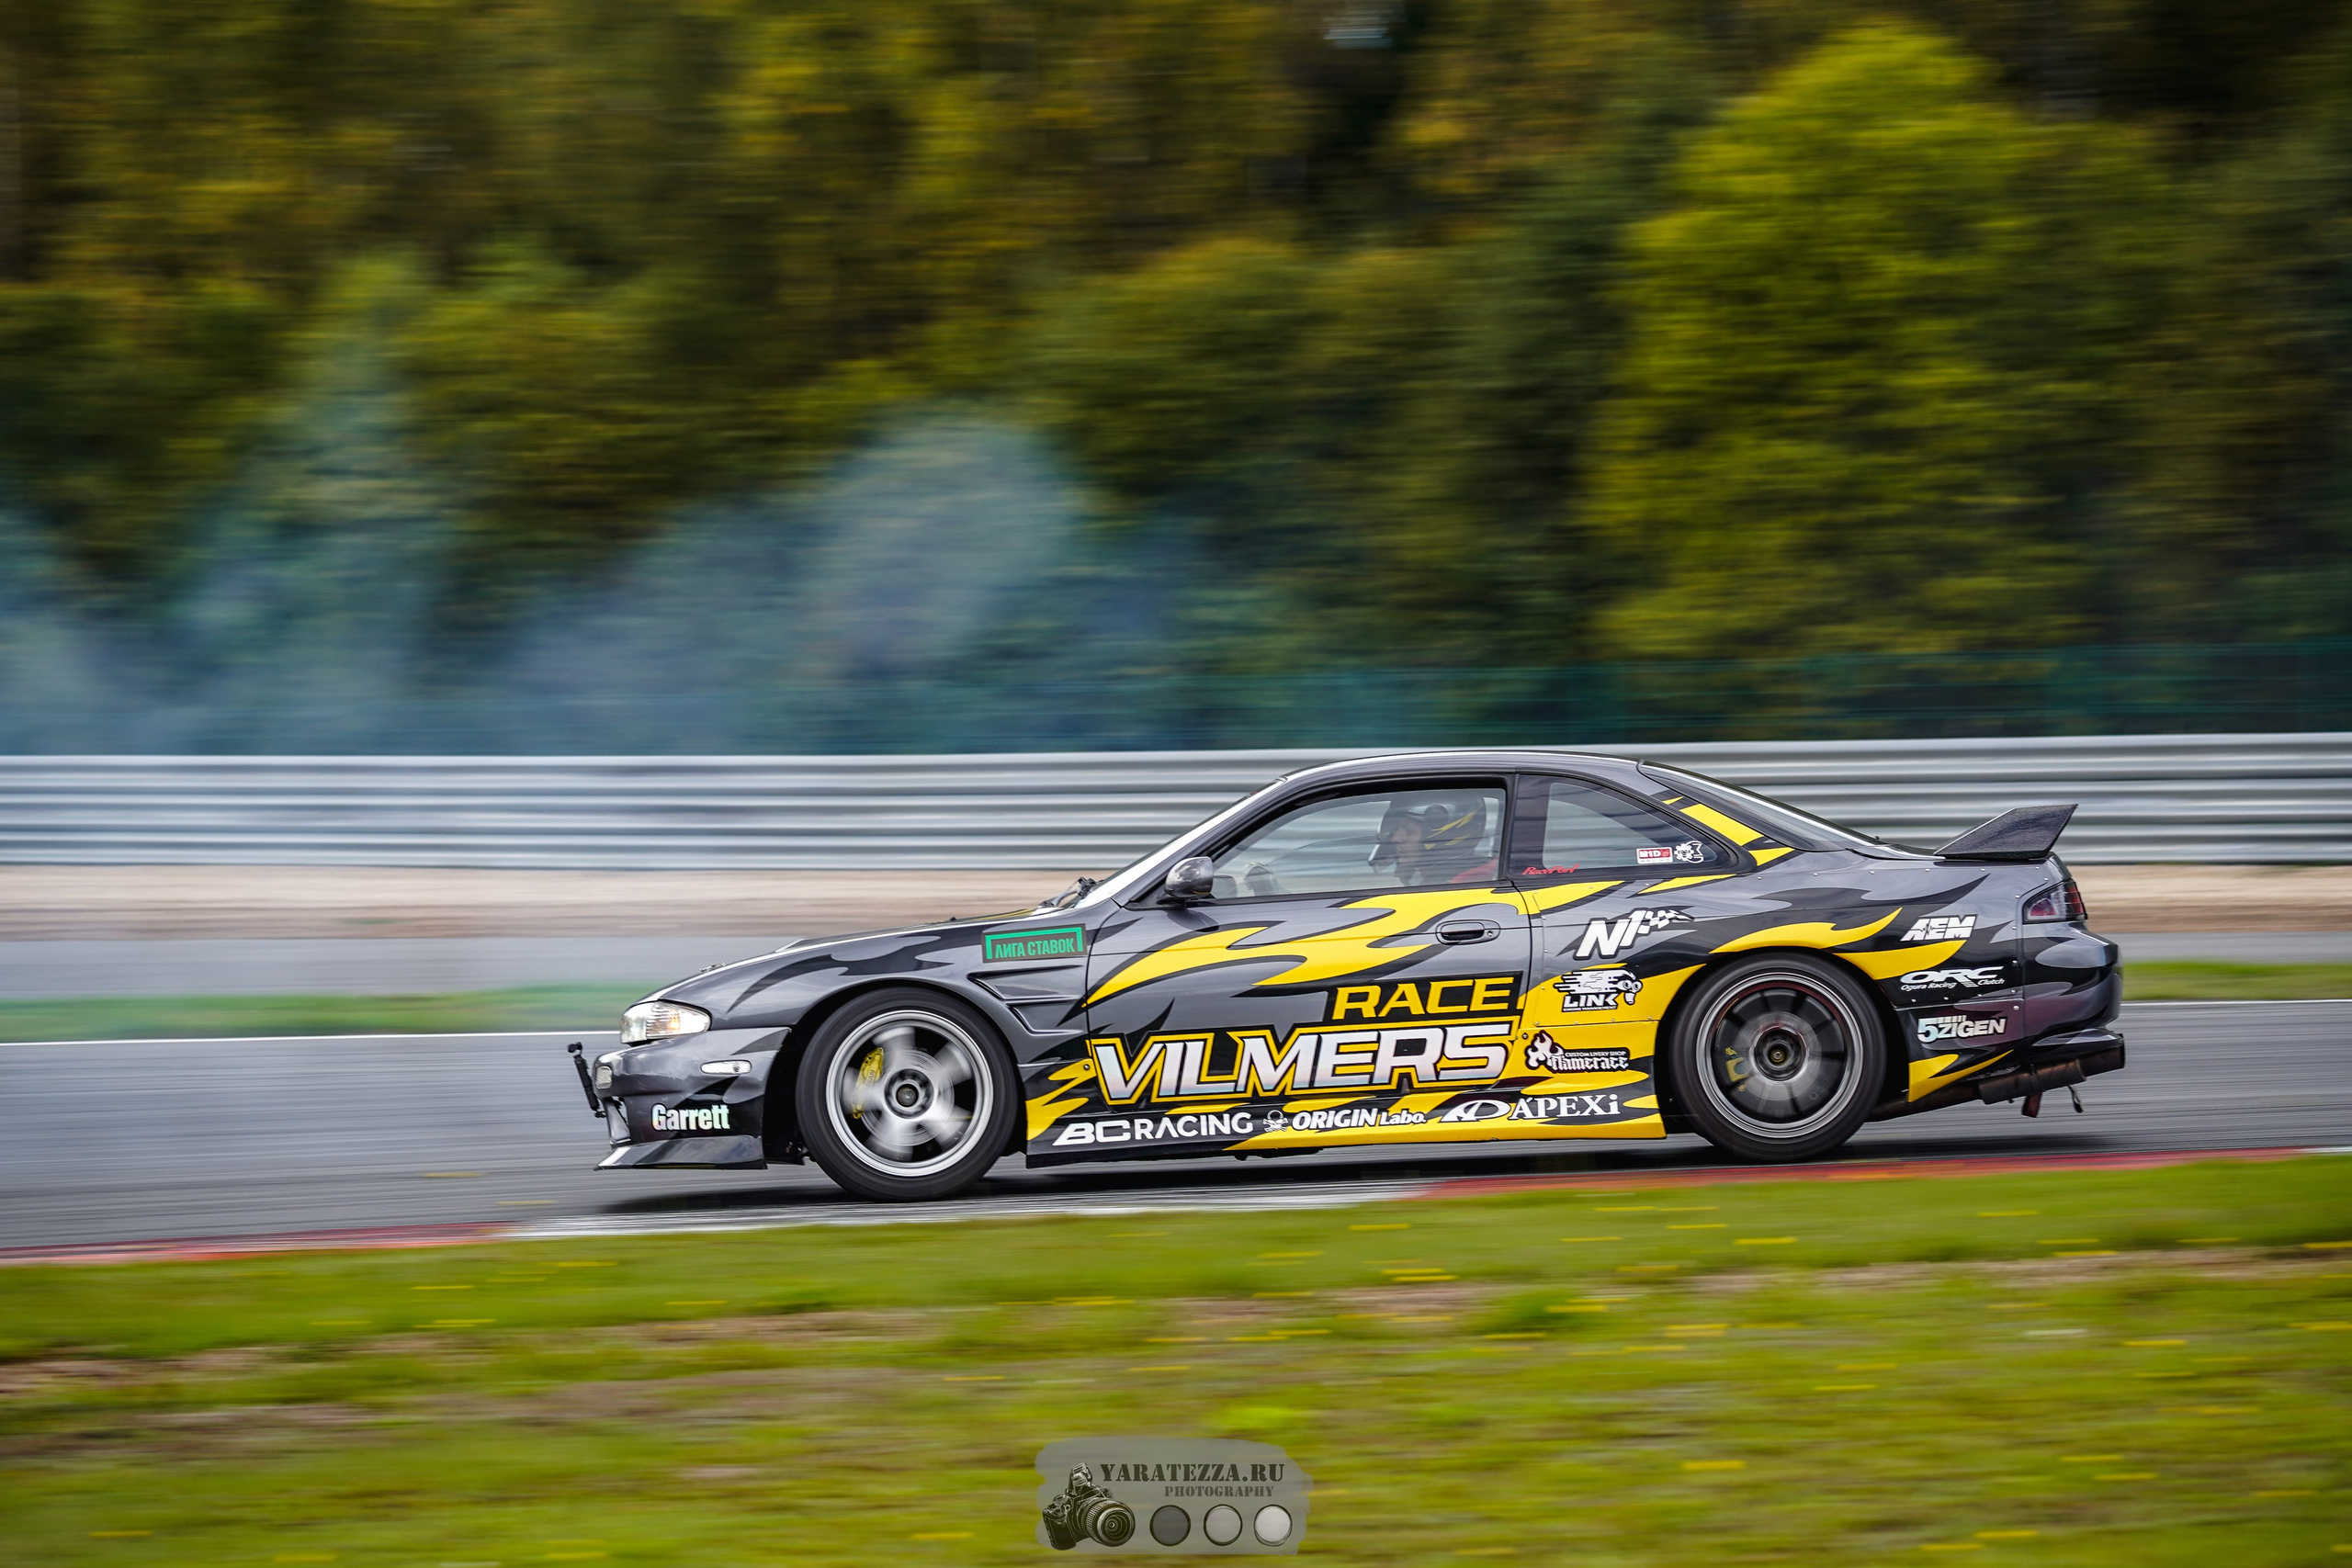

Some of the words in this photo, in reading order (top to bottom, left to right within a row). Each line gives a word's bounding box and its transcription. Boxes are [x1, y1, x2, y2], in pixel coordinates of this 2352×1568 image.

[1900, 916, 1976, 942] AEM
[995, 942, 1026, 958] ЛИГА
[1027, 938, 1075, 956] СТАВОК
[1900, 966, 2005, 986] ORC
[1900, 984, 1928, 992] Ogura
[1332, 977, 1515, 1020] RACE
[1563, 993, 1619, 1008] LINK
[1917, 1015, 2007, 1043] 5ZIGEN
[1093, 1022, 1514, 1100] VILMERS
[651, 1104, 730, 1131] Garrett
[1053, 1120, 1131, 1146] BC
[1134, 1112, 1253, 1141] RACING
[1292, 1108, 1377, 1131] ORIGIN
[1379, 1109, 1427, 1126] Labo.
